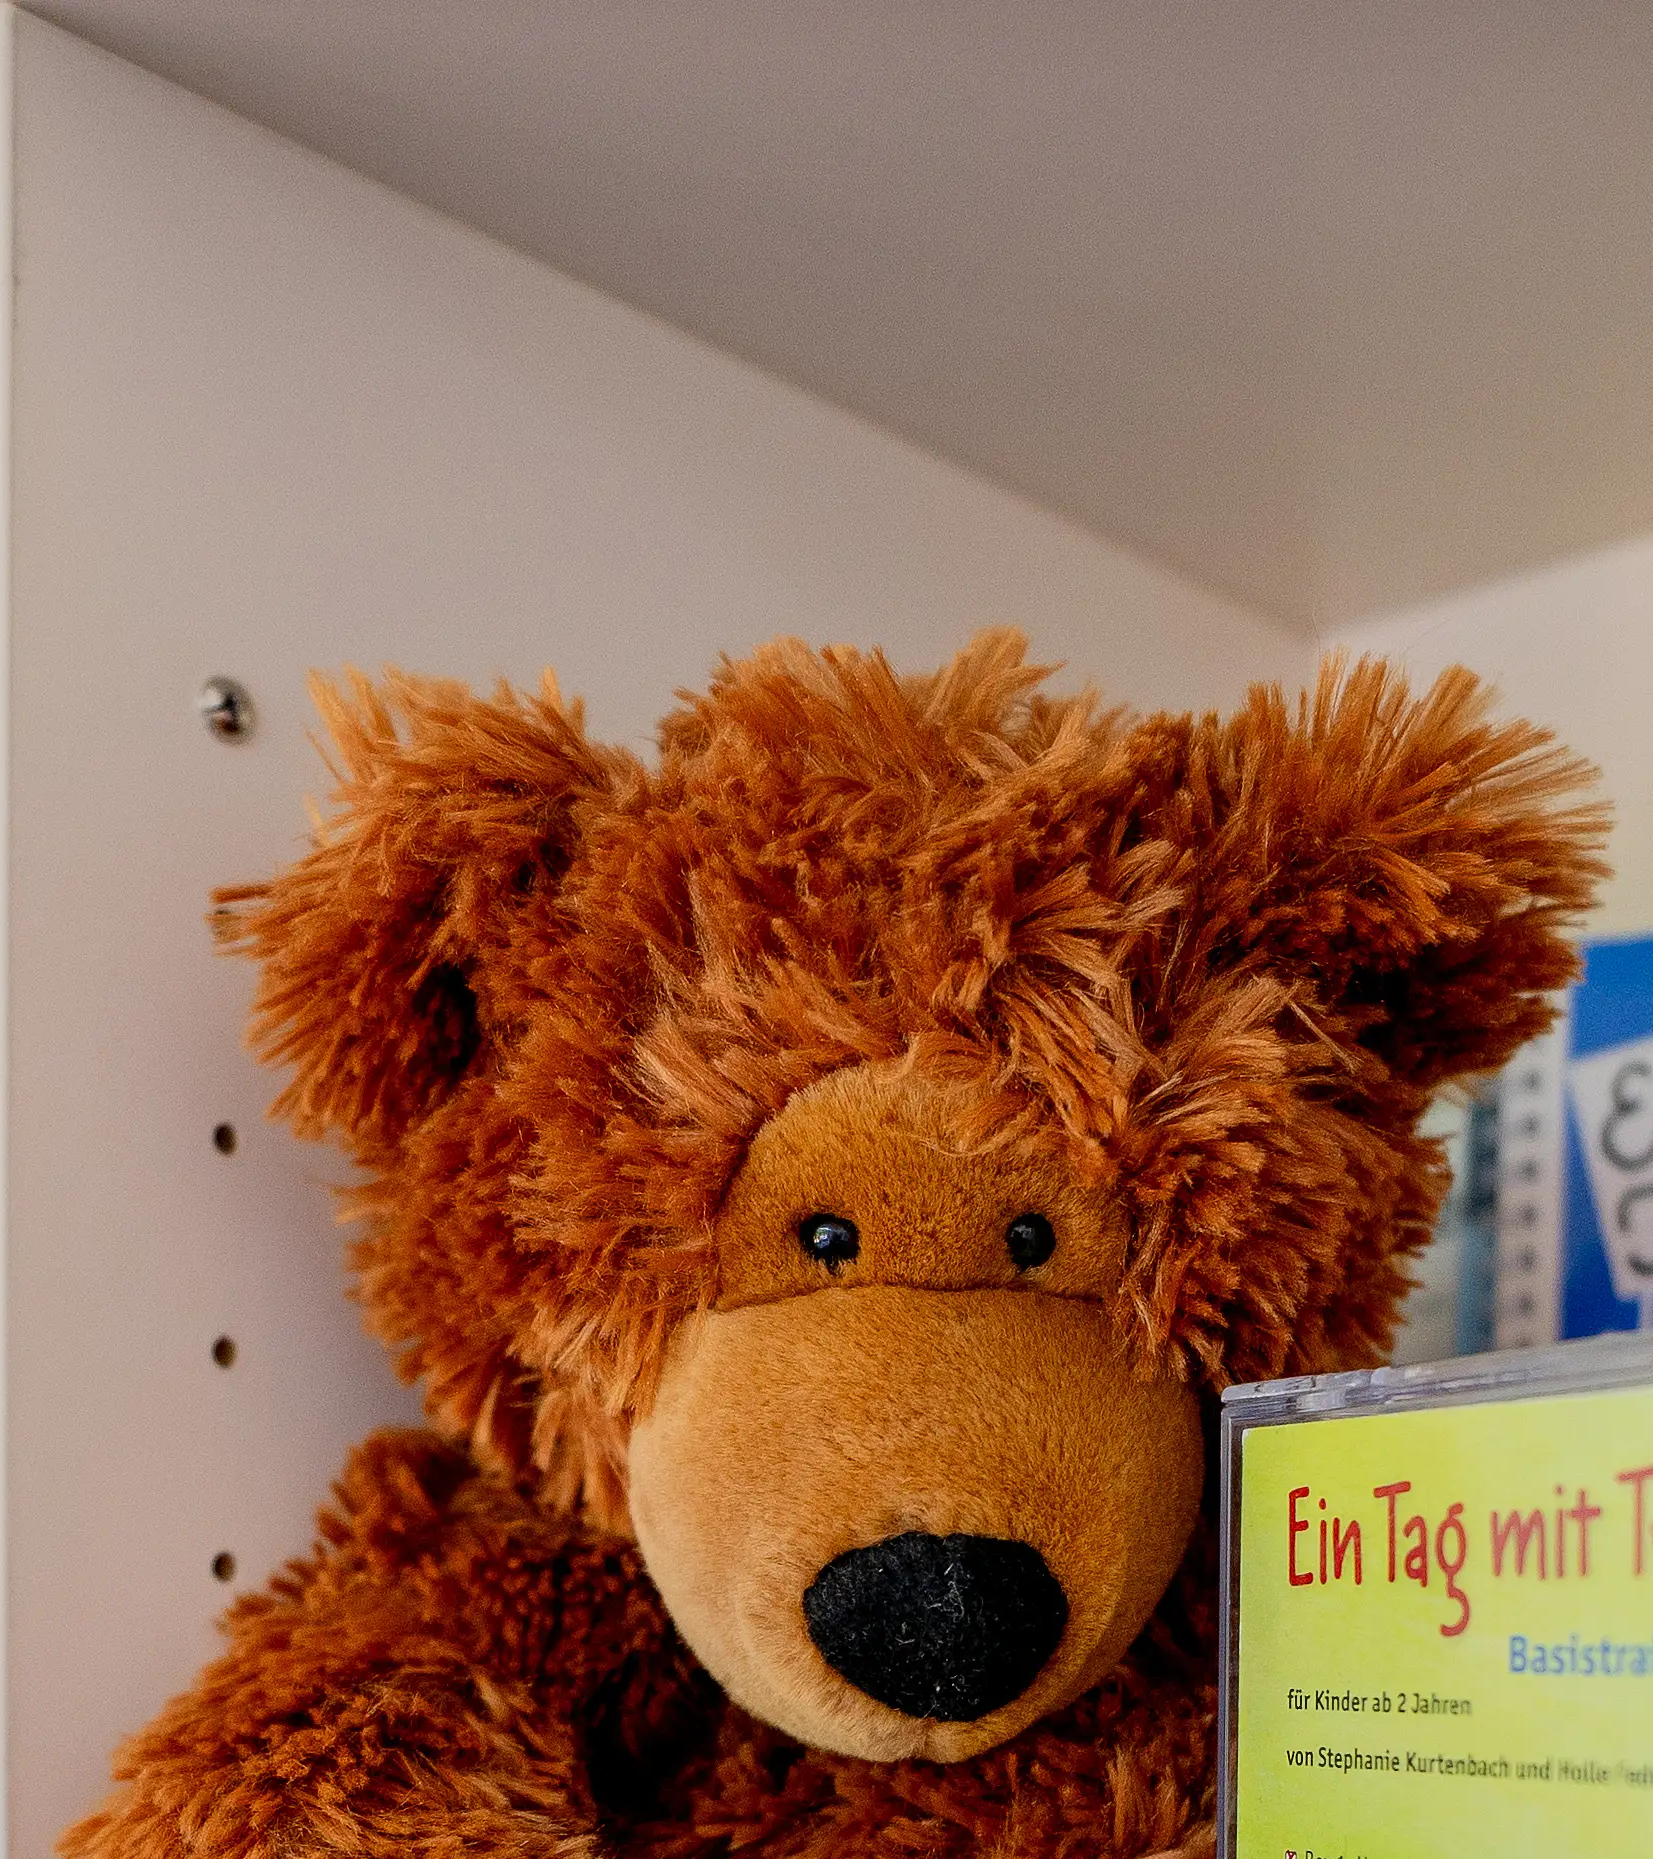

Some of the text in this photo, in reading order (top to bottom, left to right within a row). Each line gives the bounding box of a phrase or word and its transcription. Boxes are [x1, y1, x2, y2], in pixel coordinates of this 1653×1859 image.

[1286, 1485, 1365, 1587] Ein
[1373, 1480, 1471, 1638] Tag
[1489, 1486, 1601, 1581] mit
[1287, 1688, 1473, 1716] für Kinder ab 2 Jahren
[1286, 1748, 1314, 1768] von
[1318, 1747, 1401, 1774] Stephanie
[1405, 1751, 1509, 1780] Kurtenbach
[1516, 1756, 1550, 1781] und
